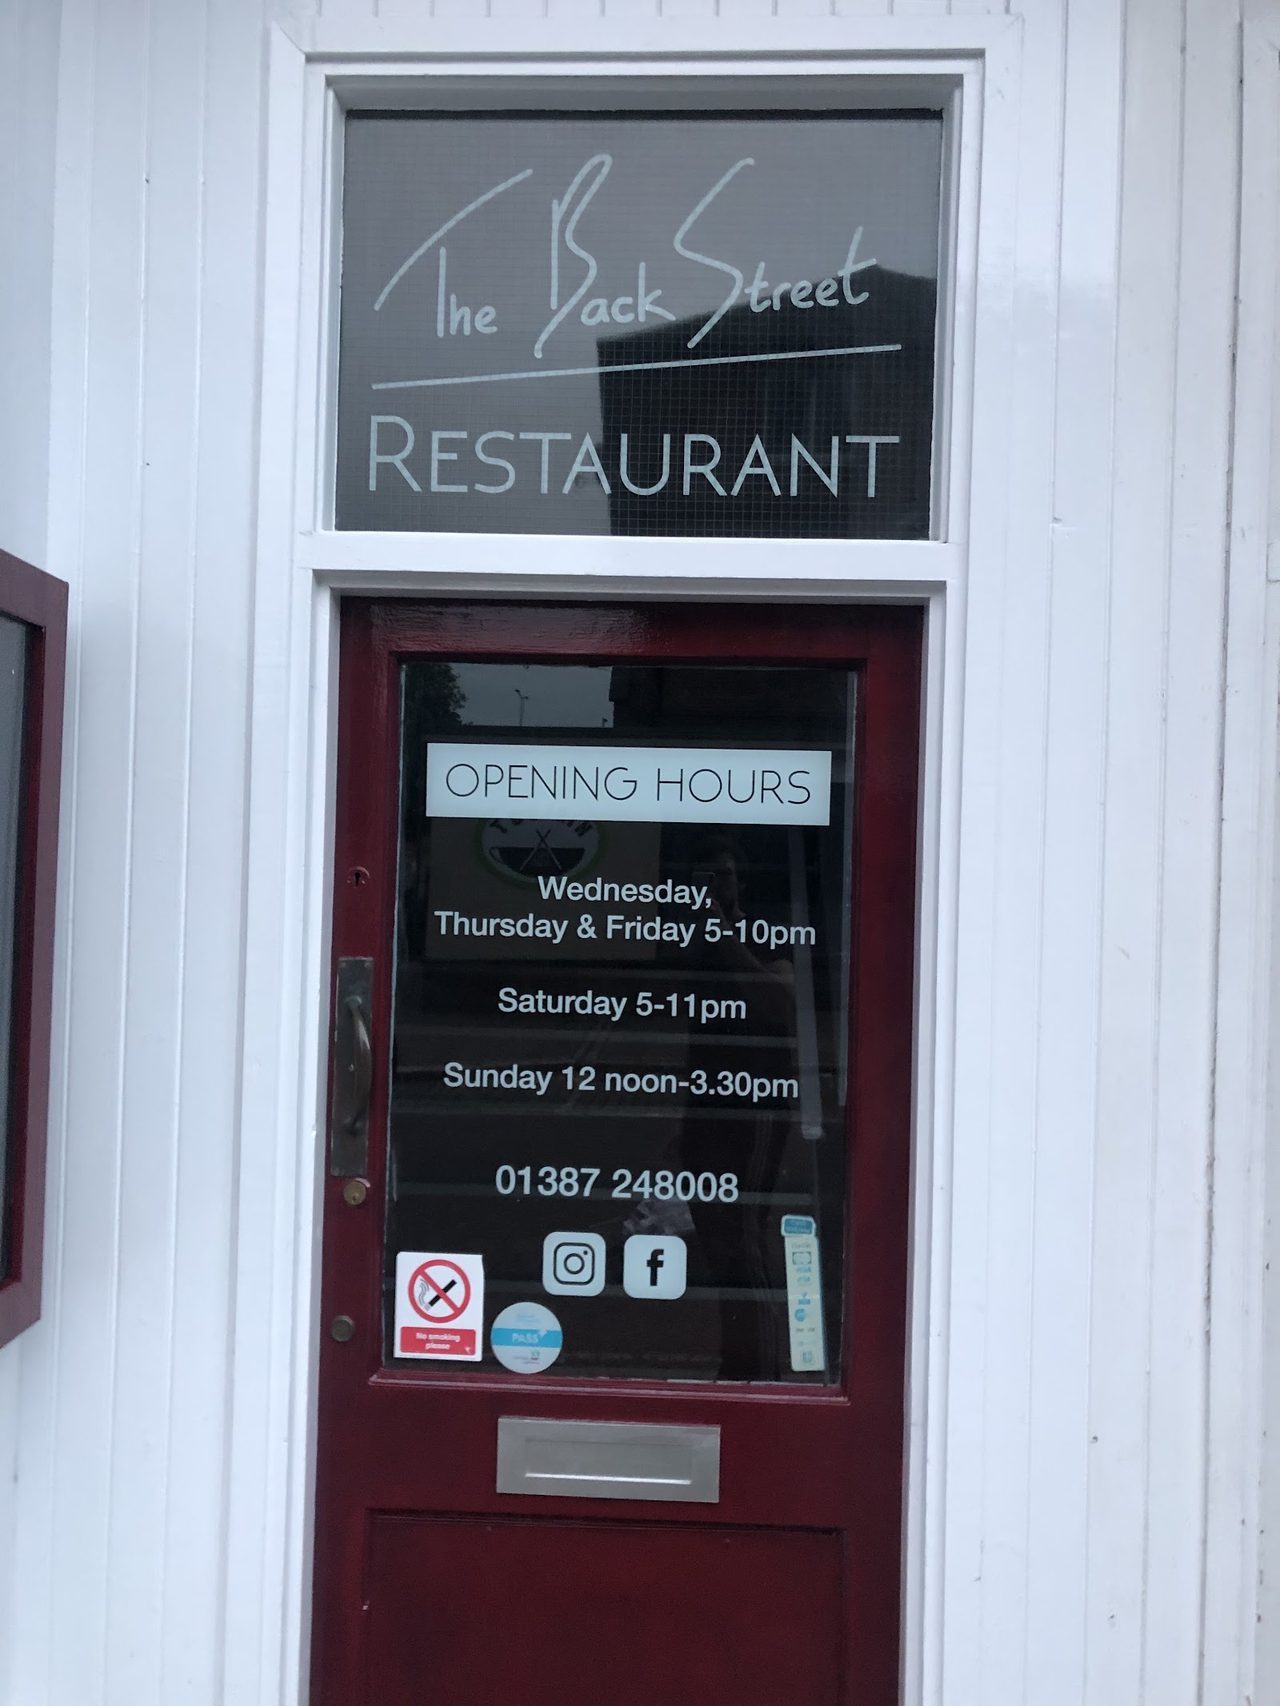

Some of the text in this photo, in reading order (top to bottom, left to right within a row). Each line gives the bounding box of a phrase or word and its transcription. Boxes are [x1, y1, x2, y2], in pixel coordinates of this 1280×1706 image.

[374, 153, 877, 359] The Back Street
[368, 414, 901, 499] RESTAURANT
[445, 763, 812, 804] OPENING HOURS
[537, 875, 713, 910] Wednesday,
[434, 911, 816, 950] Thursday & Friday 5-10pm
[498, 987, 747, 1024] Saturday 5-11pm
[443, 1062, 799, 1102] Sunday 12 noon-3.30pm
[495, 1165, 739, 1202] 01387 248008
[415, 1332, 461, 1343] No smoking
[424, 1342, 451, 1350] please
[511, 1332, 539, 1344] PASS
